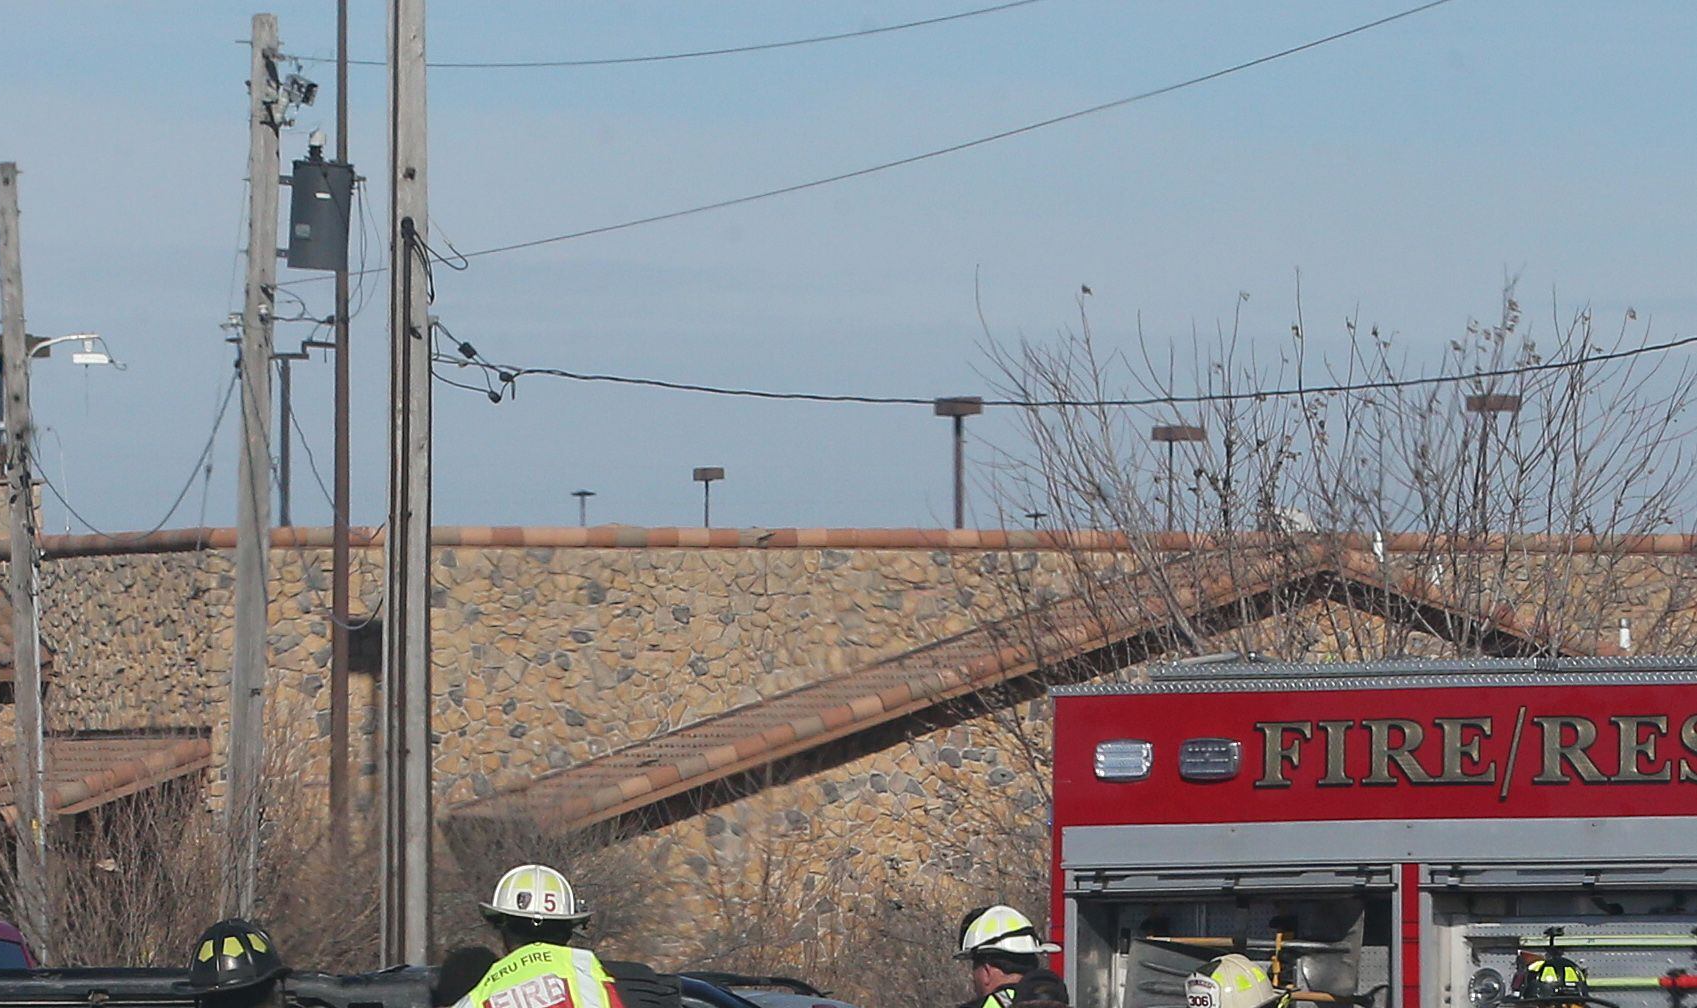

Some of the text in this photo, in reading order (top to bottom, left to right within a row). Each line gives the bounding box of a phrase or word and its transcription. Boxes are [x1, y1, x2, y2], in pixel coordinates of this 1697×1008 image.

[543, 893, 557, 912] 5
[521, 950, 553, 967] FIRE
[1188, 995, 1210, 1007] 306
